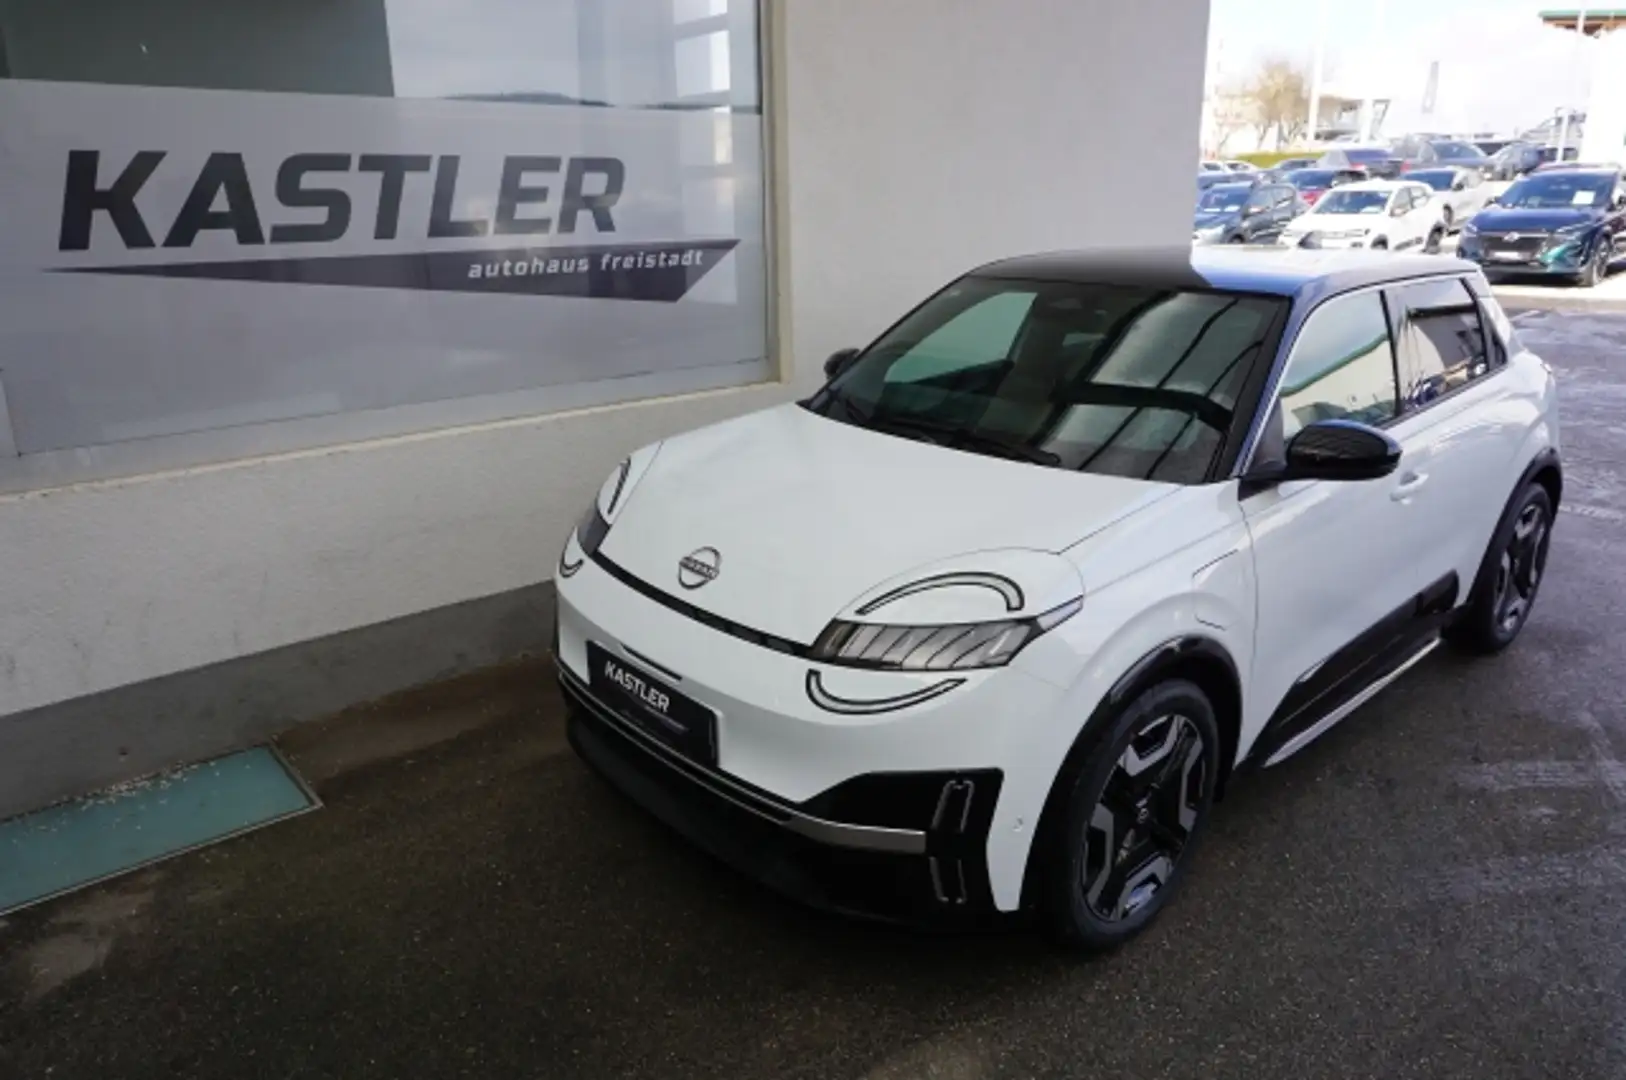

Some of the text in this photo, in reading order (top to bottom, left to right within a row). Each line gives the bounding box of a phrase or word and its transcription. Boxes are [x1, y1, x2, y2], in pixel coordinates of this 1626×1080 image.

[58, 149, 626, 251] KASTLER
[467, 249, 704, 279] autohaus freistadt
[604, 660, 670, 713] KASTLER
